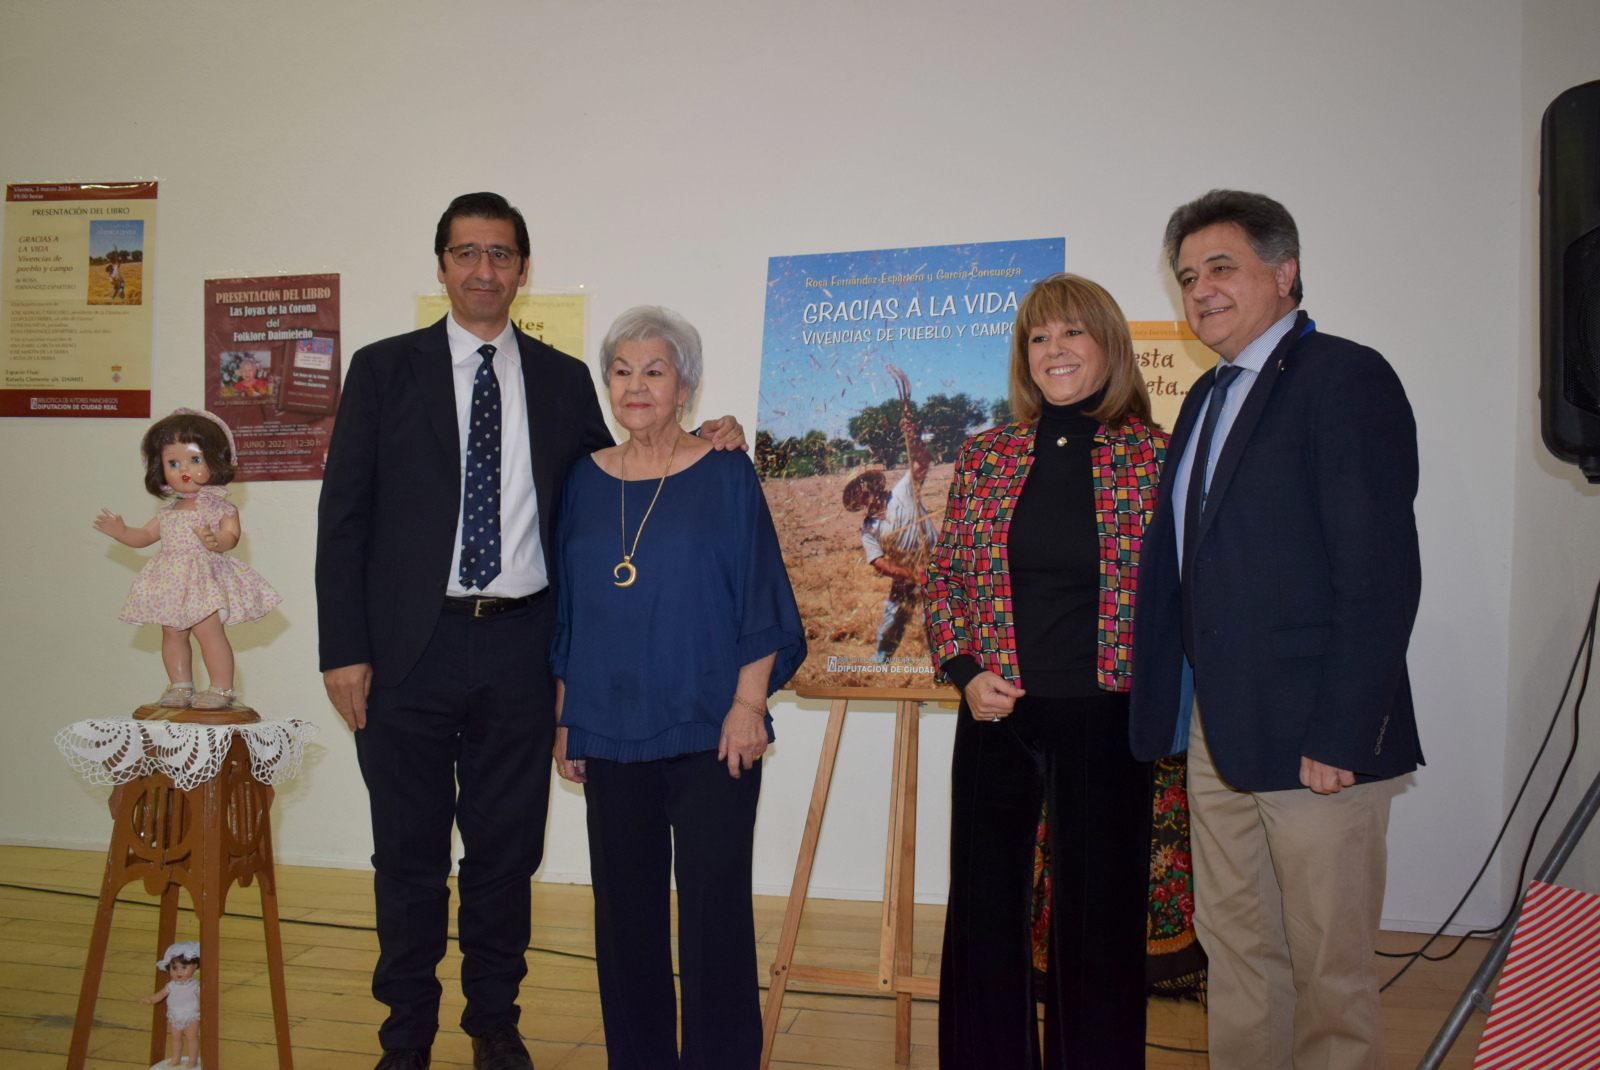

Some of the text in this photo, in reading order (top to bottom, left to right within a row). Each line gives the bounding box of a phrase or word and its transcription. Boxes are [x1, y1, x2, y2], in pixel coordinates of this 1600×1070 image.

[32, 207, 88, 216] PRESENTACIÓN
[107, 207, 130, 215] LIBRO
[16, 265, 42, 274] pueblo
[50, 266, 74, 274] campo
[806, 266, 1021, 288] Rosa Fernández-Espartero y García-Consuegra
[216, 287, 331, 304] PRESENTACIÓN DEL LIBRO
[230, 304, 316, 317] Las Joyas de la Corona
[803, 291, 1018, 324] GRACIAS A LA VIDA
[266, 319, 280, 328] del
[234, 328, 313, 342] Folklore Daimieleño
[802, 329, 871, 345] VIVENCIAS
[877, 328, 894, 341] DE
[900, 325, 952, 340] PUEBLO
[956, 325, 966, 337] Y
[242, 441, 265, 449] JUNIO
[268, 440, 286, 448] 2022
[296, 439, 315, 447] 12:30
[886, 657, 914, 665] AUTORES
[838, 665, 935, 674] DIPUTACION DE CIUDAD
